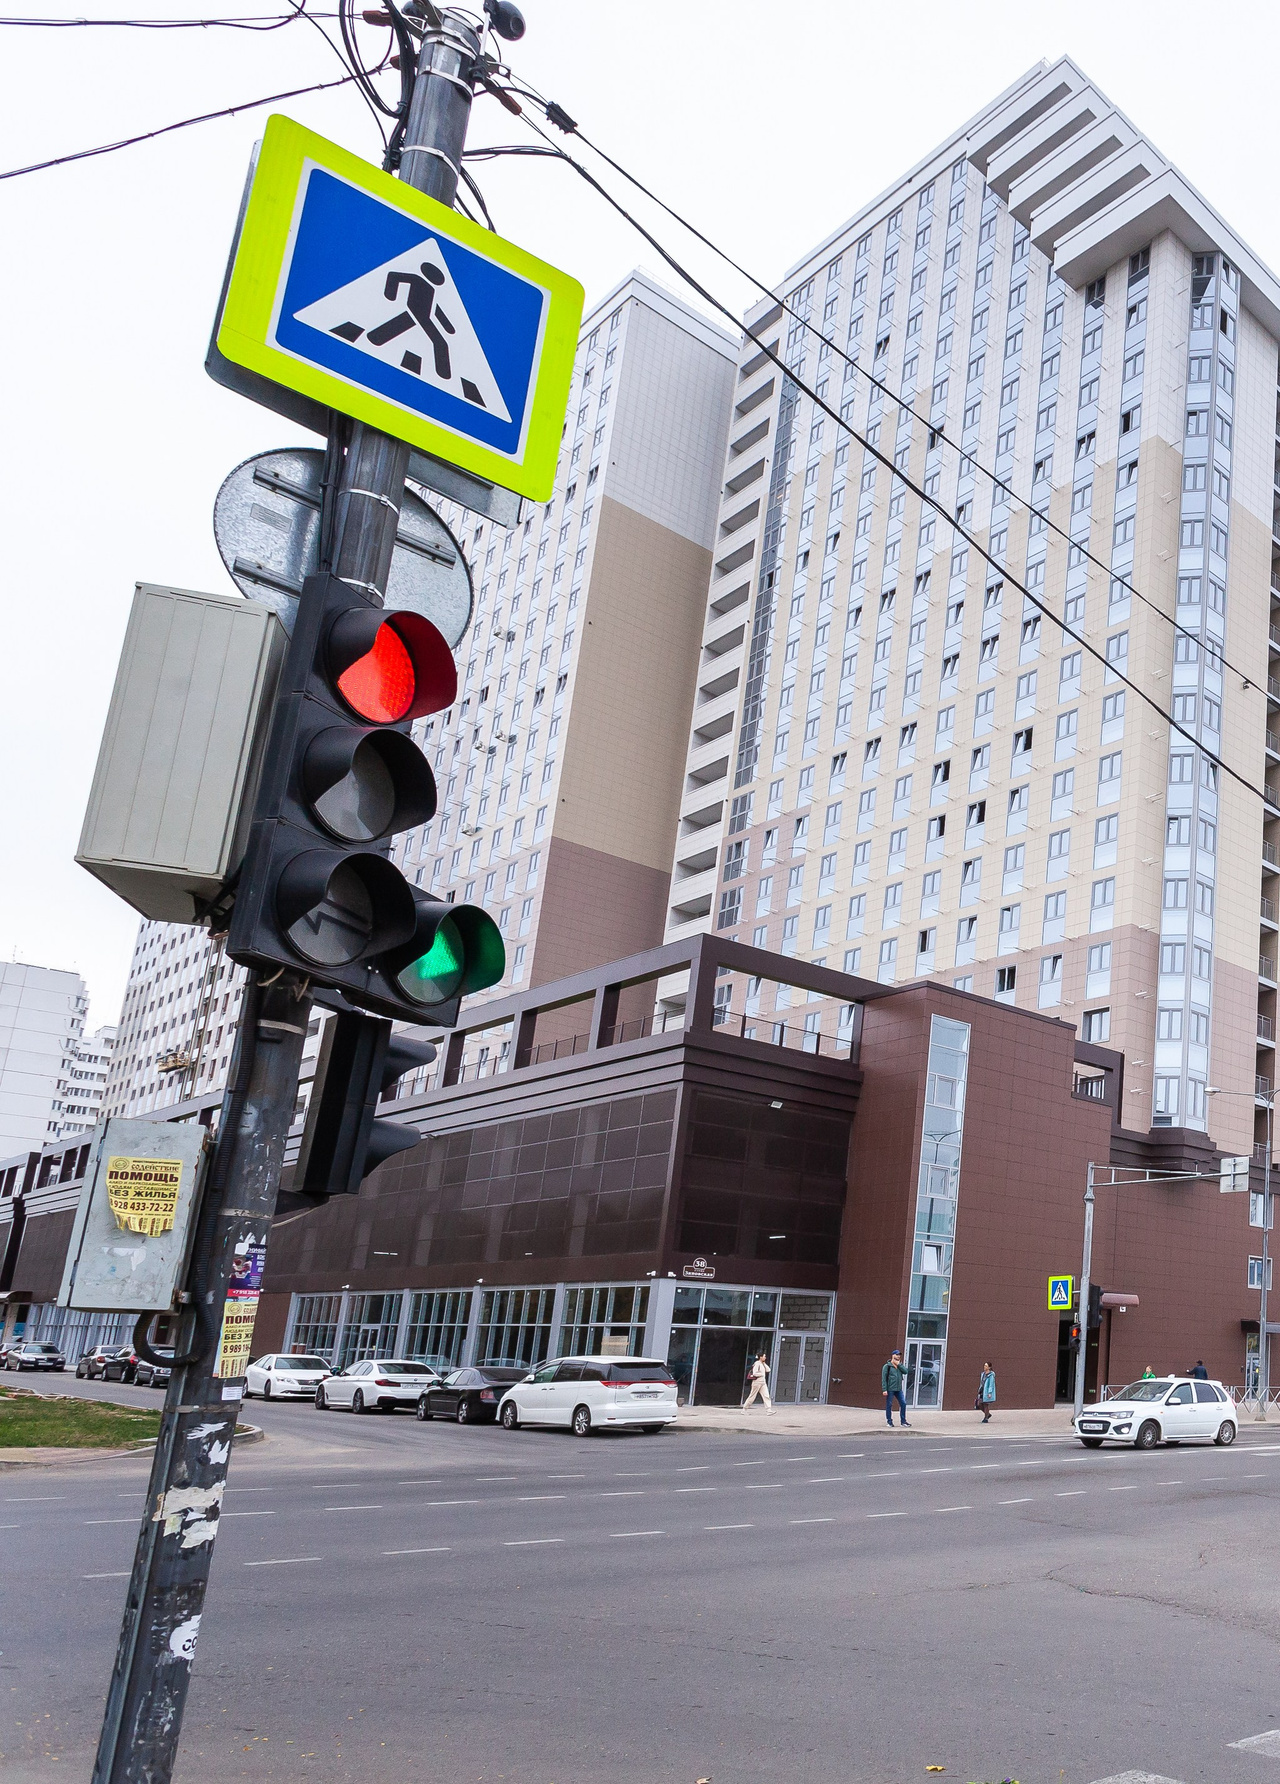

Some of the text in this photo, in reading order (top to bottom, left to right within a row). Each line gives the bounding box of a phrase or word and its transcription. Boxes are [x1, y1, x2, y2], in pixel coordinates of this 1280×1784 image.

[108, 1171, 179, 1183] ПОМОЩЬ
[133, 1190, 176, 1199] ЖИЛЬЯ
[130, 1201, 174, 1213] 433-72-22
[223, 1345, 228, 1353] 8
[229, 1345, 241, 1353] 989
